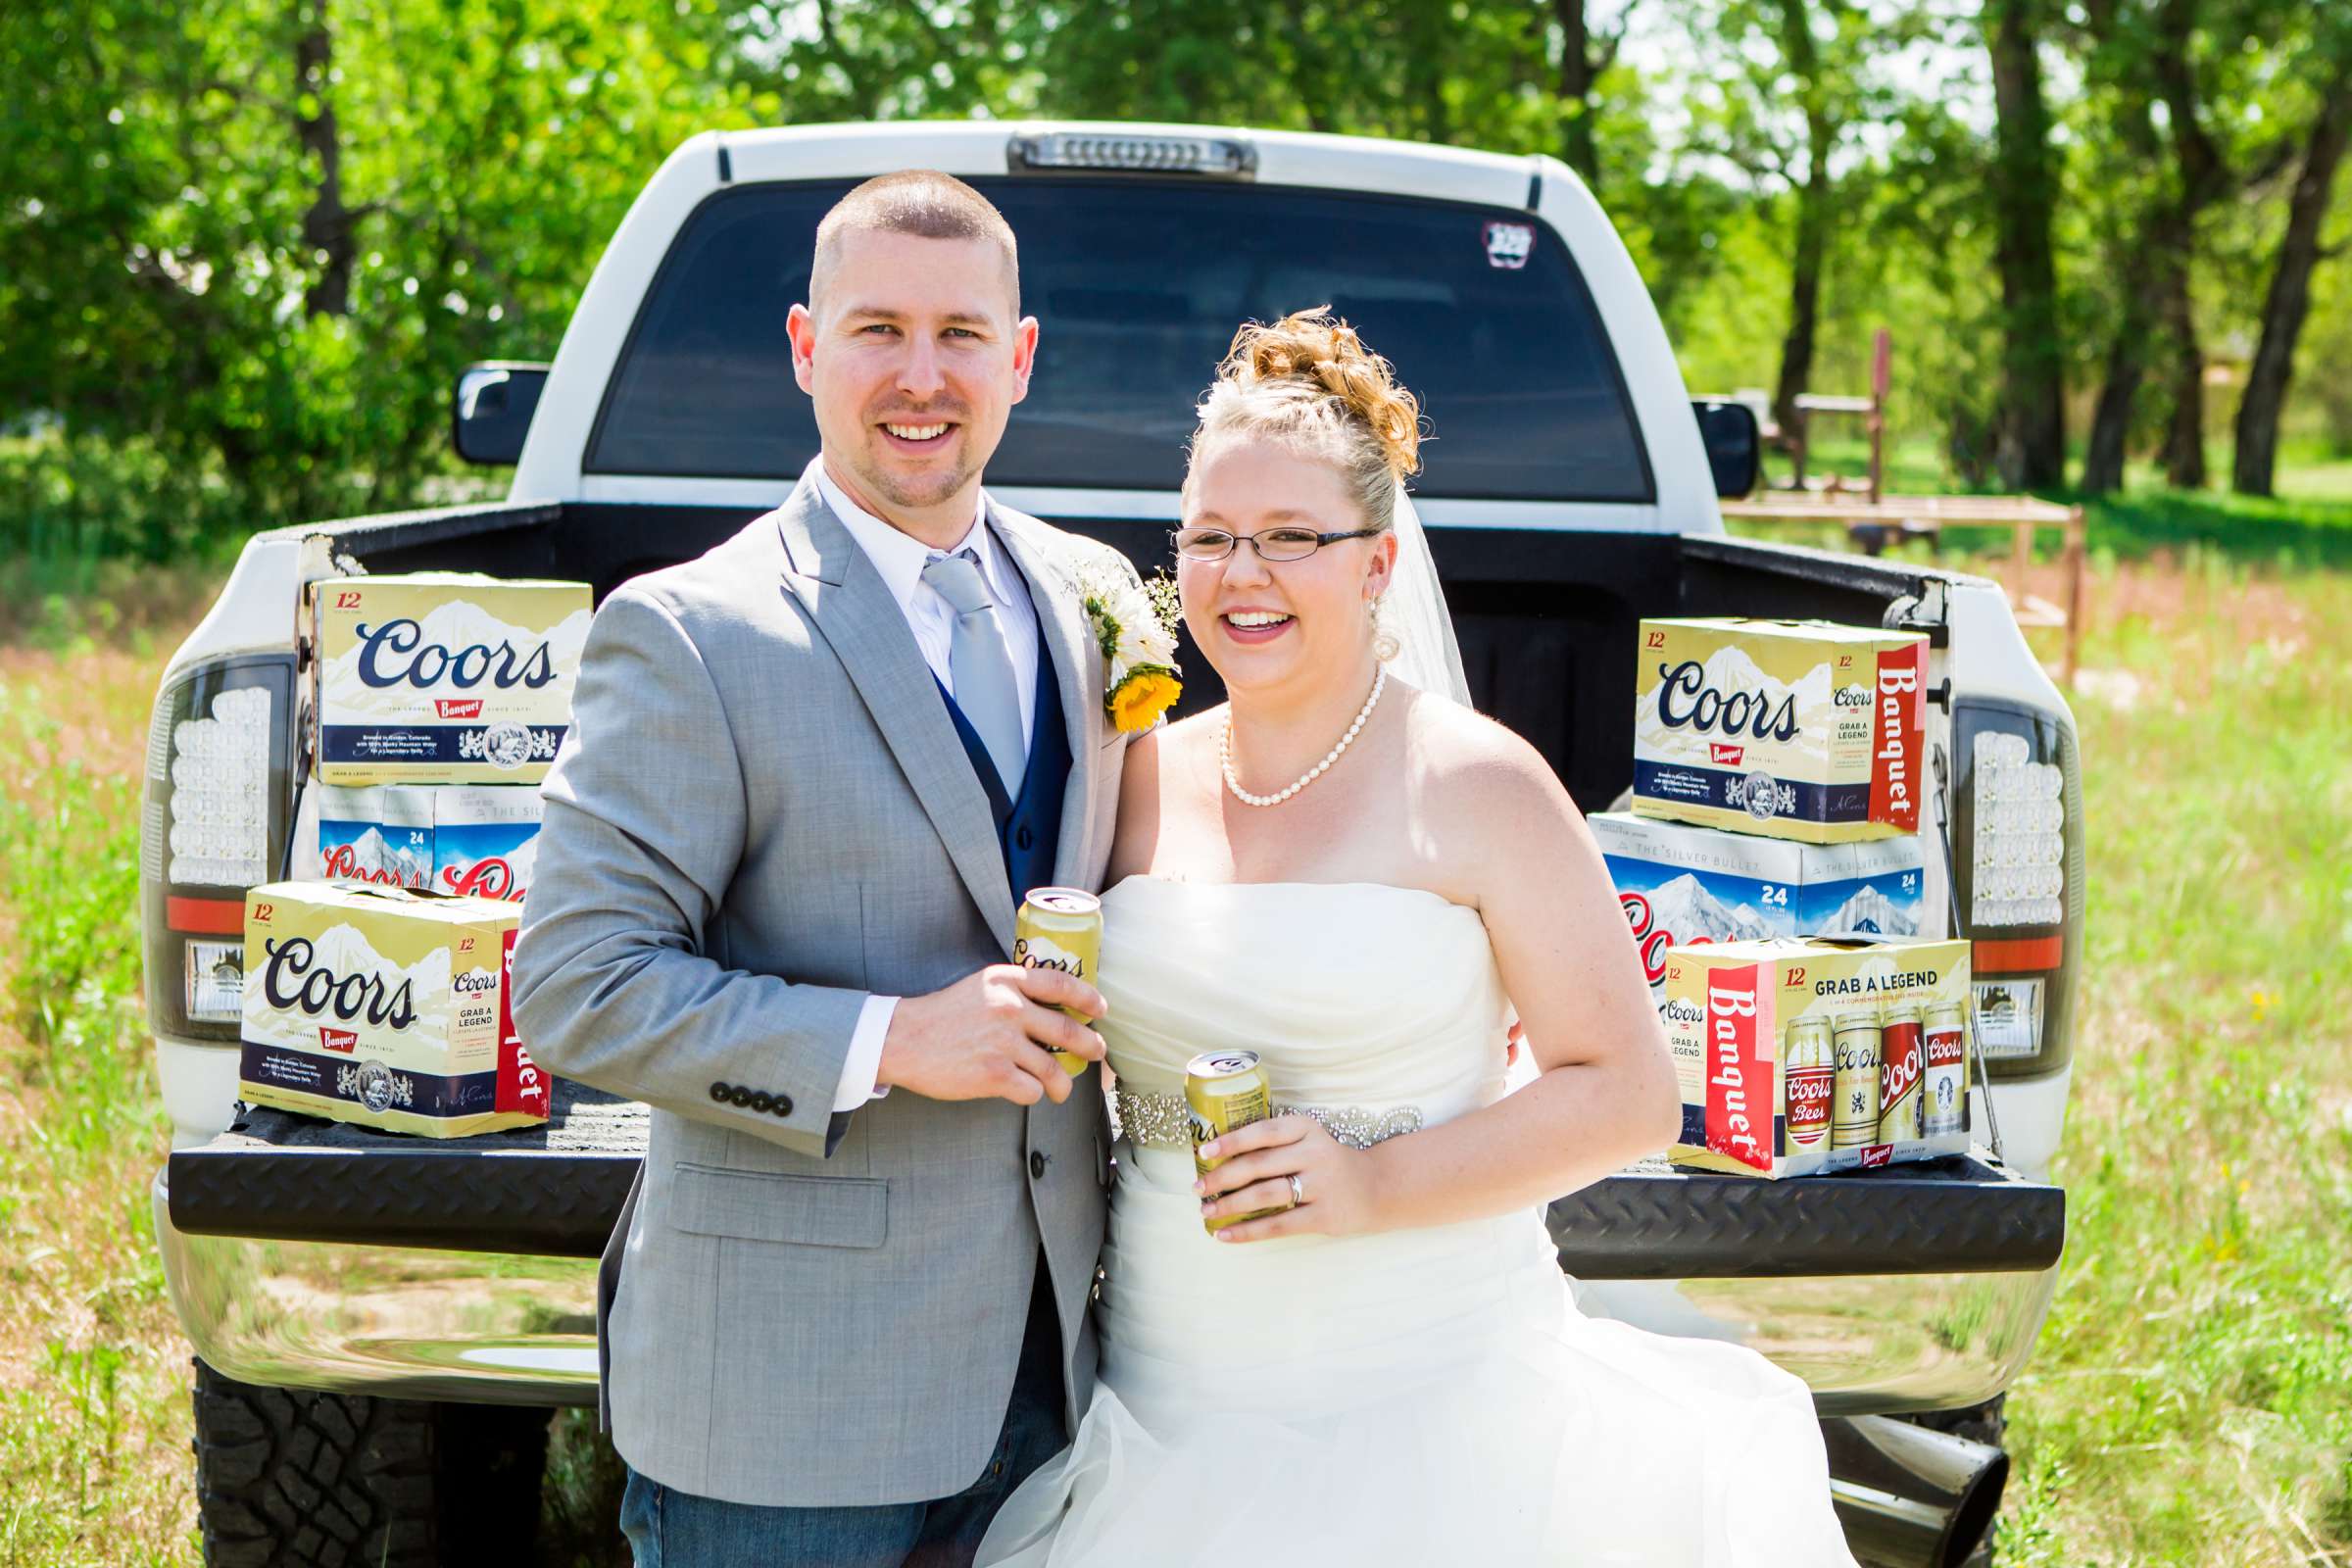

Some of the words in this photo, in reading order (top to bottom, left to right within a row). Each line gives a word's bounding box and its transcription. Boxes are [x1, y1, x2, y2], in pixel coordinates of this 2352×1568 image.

[335, 591, 362, 609] 12
[1646, 632, 1665, 648] 12
[356, 618, 557, 689] Coors
[1839, 656, 1852, 667] 12
[1659, 661, 1800, 742] Coors
[1834, 687, 1872, 707] Coors
[441, 701, 479, 717] Banquet
[1838, 730, 1868, 739] LEGEND
[1878, 666, 1918, 812] Banquet
[410, 831, 424, 845] 24
[1636, 843, 1658, 856] THE
[1665, 849, 1707, 863] SILVER
[1901, 873, 1915, 888] 24
[1761, 885, 1788, 906] 24
[254, 903, 273, 921] 12
[460, 938, 474, 951] 12
[455, 971, 498, 993] Coors
[1669, 967, 1682, 979] 12
[1786, 967, 1805, 986] 12
[1815, 978, 1861, 997] GRAB
[1866, 975, 1877, 991] A
[1882, 970, 1937, 990] LEGEND
[266, 937, 416, 1030] Coors
[460, 1008, 484, 1018] GRAB
[486, 1006, 492, 1015] A
[1667, 1000, 1703, 1022] Coors
[459, 1016, 493, 1027] LEGEND
[324, 1030, 354, 1049] Banquet
[1671, 1037, 1692, 1048] GRAB
[1929, 1038, 1962, 1060] Coors
[1709, 986, 1758, 1152] Banquet
[1880, 1034, 1924, 1110] Coor
[1788, 1077, 1832, 1102] Coors
[1792, 1104, 1826, 1122] Beer
[1863, 1146, 1890, 1164] Banquet
